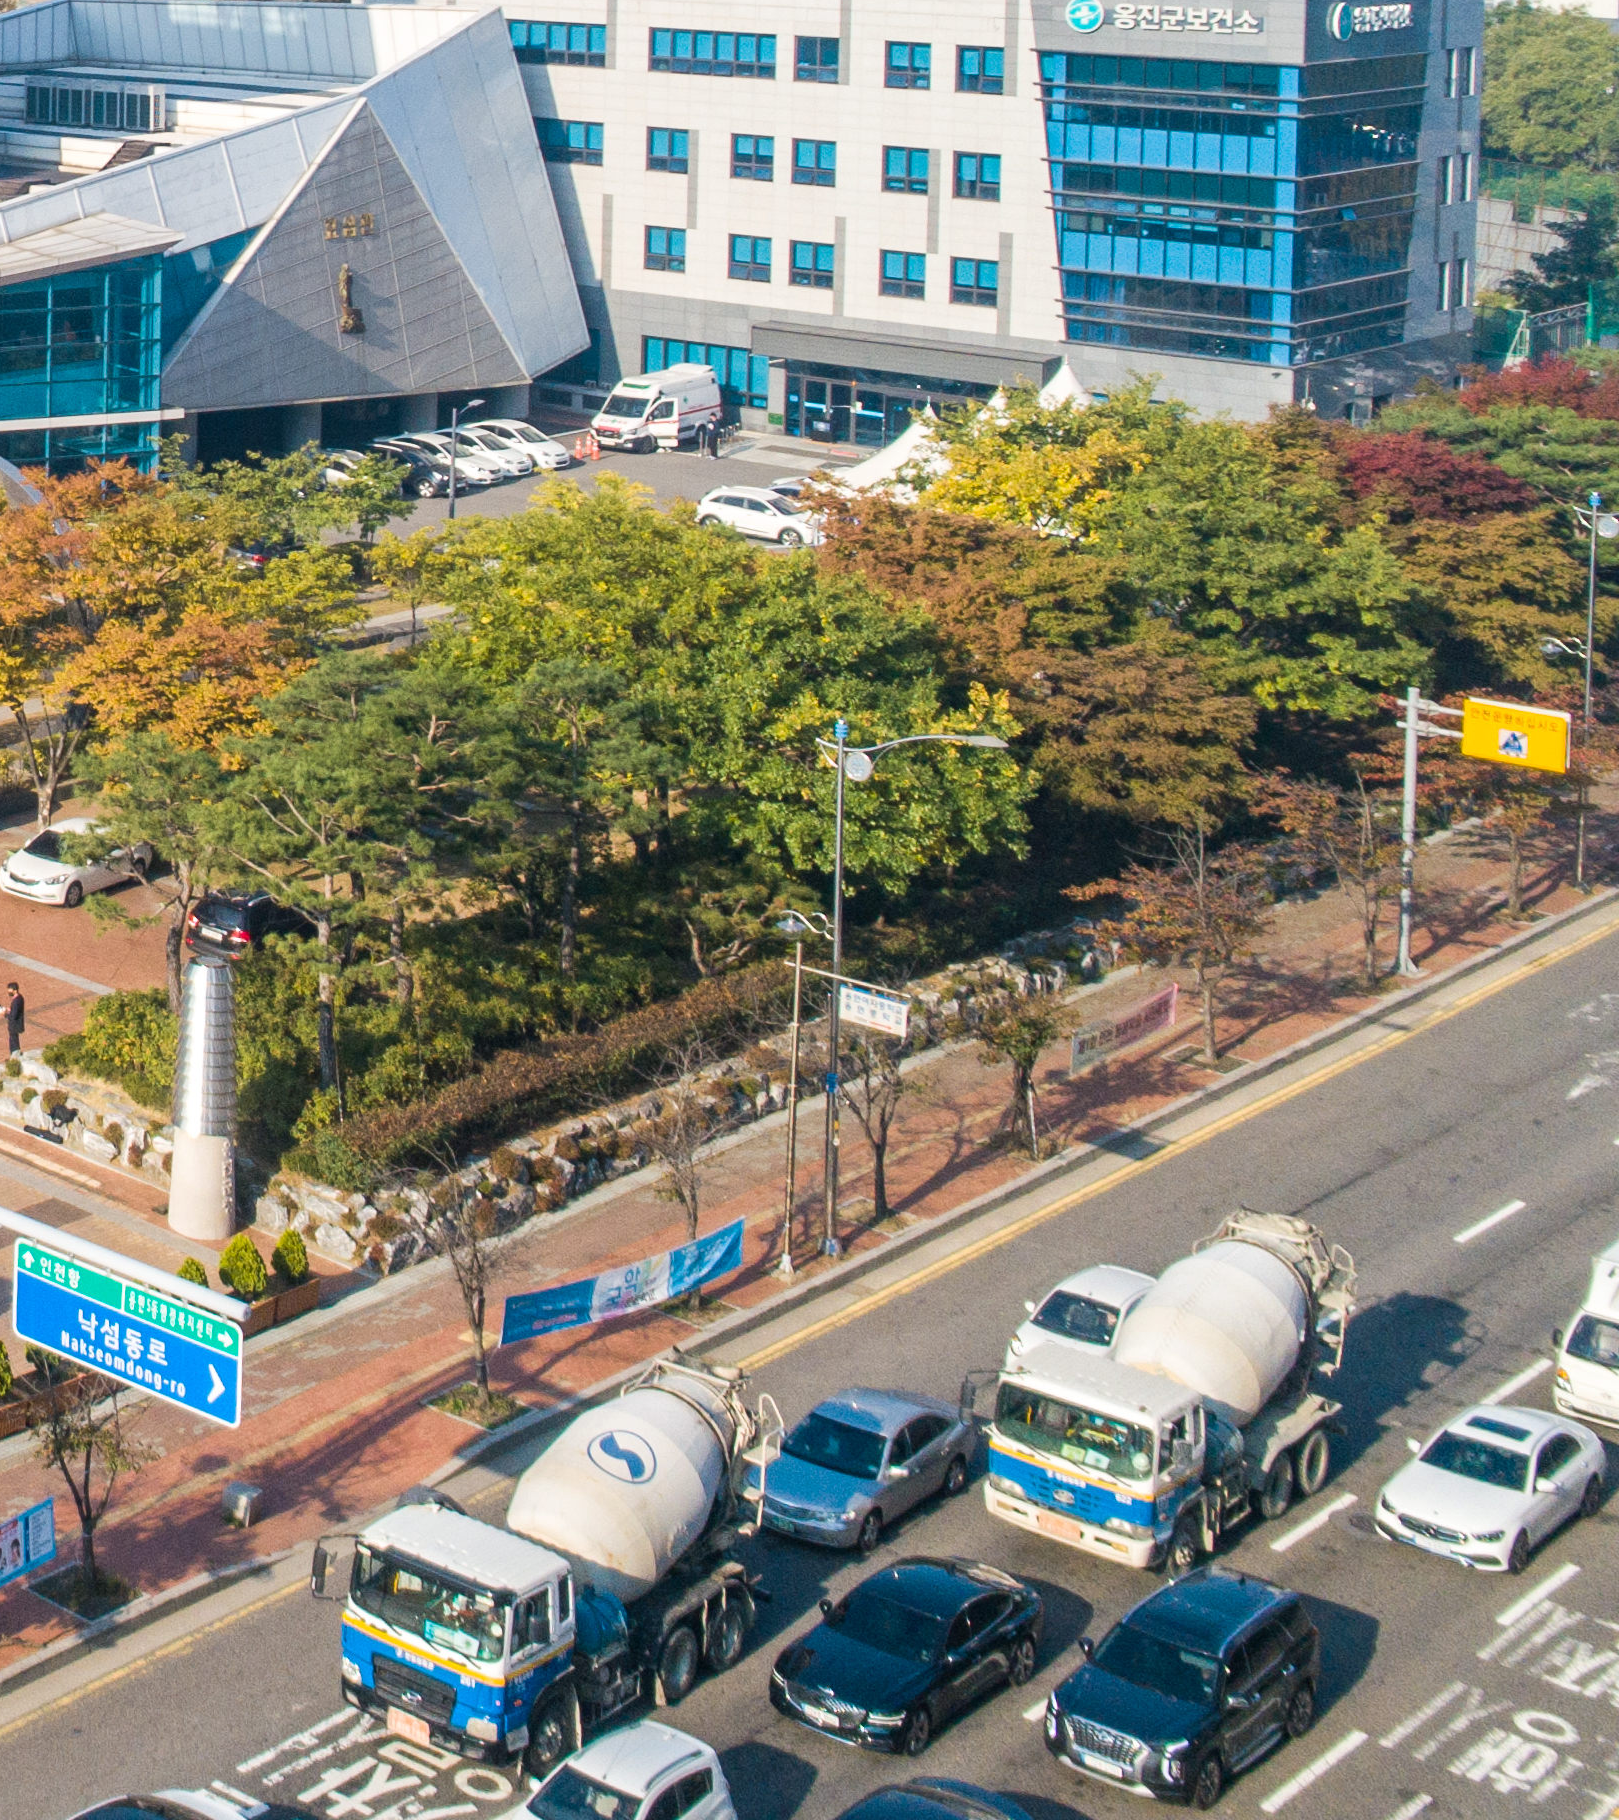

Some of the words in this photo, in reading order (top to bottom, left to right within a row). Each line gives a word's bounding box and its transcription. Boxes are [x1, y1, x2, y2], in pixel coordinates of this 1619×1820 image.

[1112, 3, 1260, 34] 옹진군보건소
[1470, 707, 1559, 732] 안전운행하십시오
[39, 1256, 80, 1288] 인천항
[128, 1291, 214, 1340] 용현5동행정복지센터
[78, 1309, 168, 1366] 낙섬동로
[61, 1330, 186, 1398] Nakseomdong-ro
